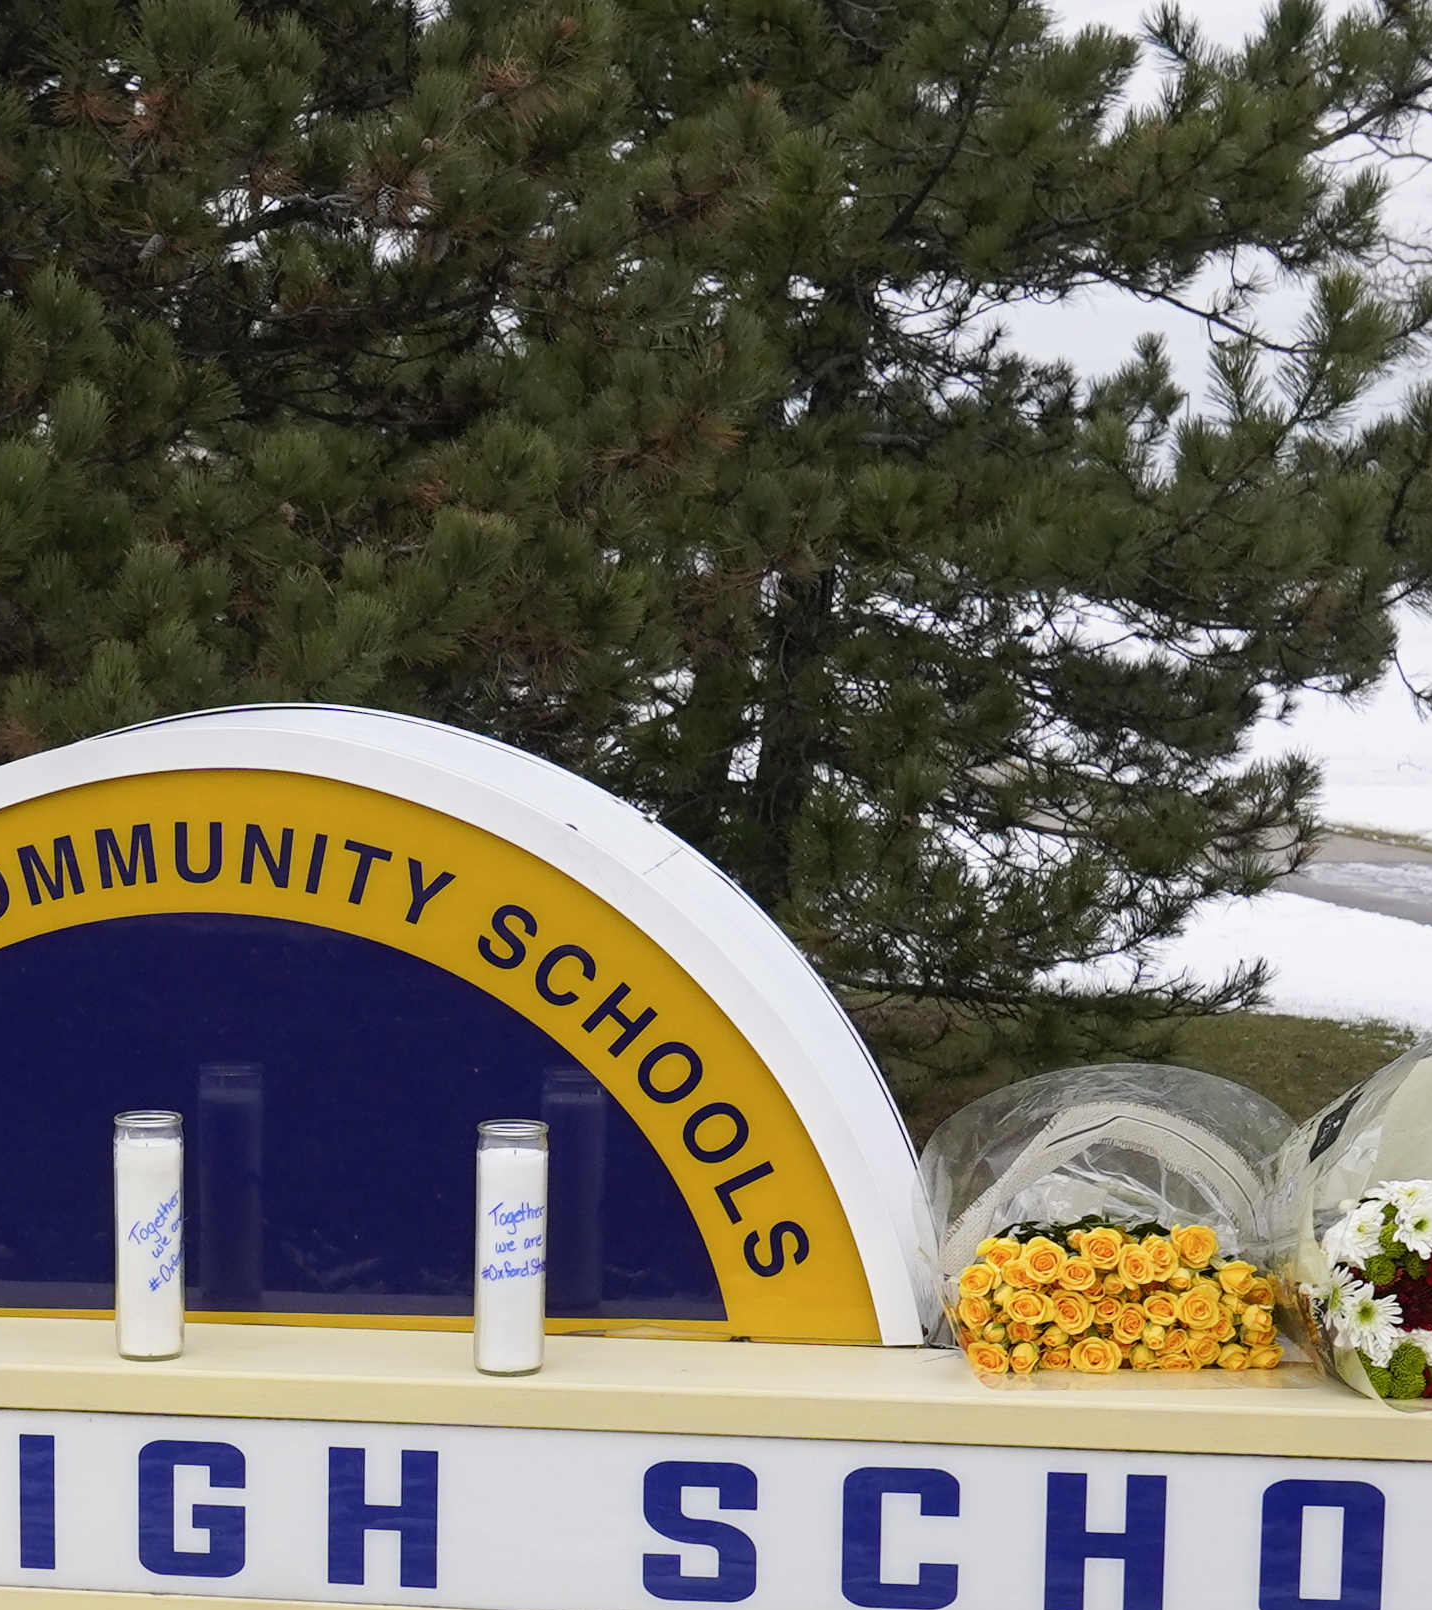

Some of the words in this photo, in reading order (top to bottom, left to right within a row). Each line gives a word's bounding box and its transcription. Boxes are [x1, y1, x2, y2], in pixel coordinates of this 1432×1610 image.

[476, 903, 812, 1280] SCHOOLS
[127, 1190, 179, 1246] Together
[487, 1201, 545, 1236] Together
[151, 1235, 173, 1259] we
[494, 1239, 517, 1254] we
[523, 1233, 543, 1250] are
